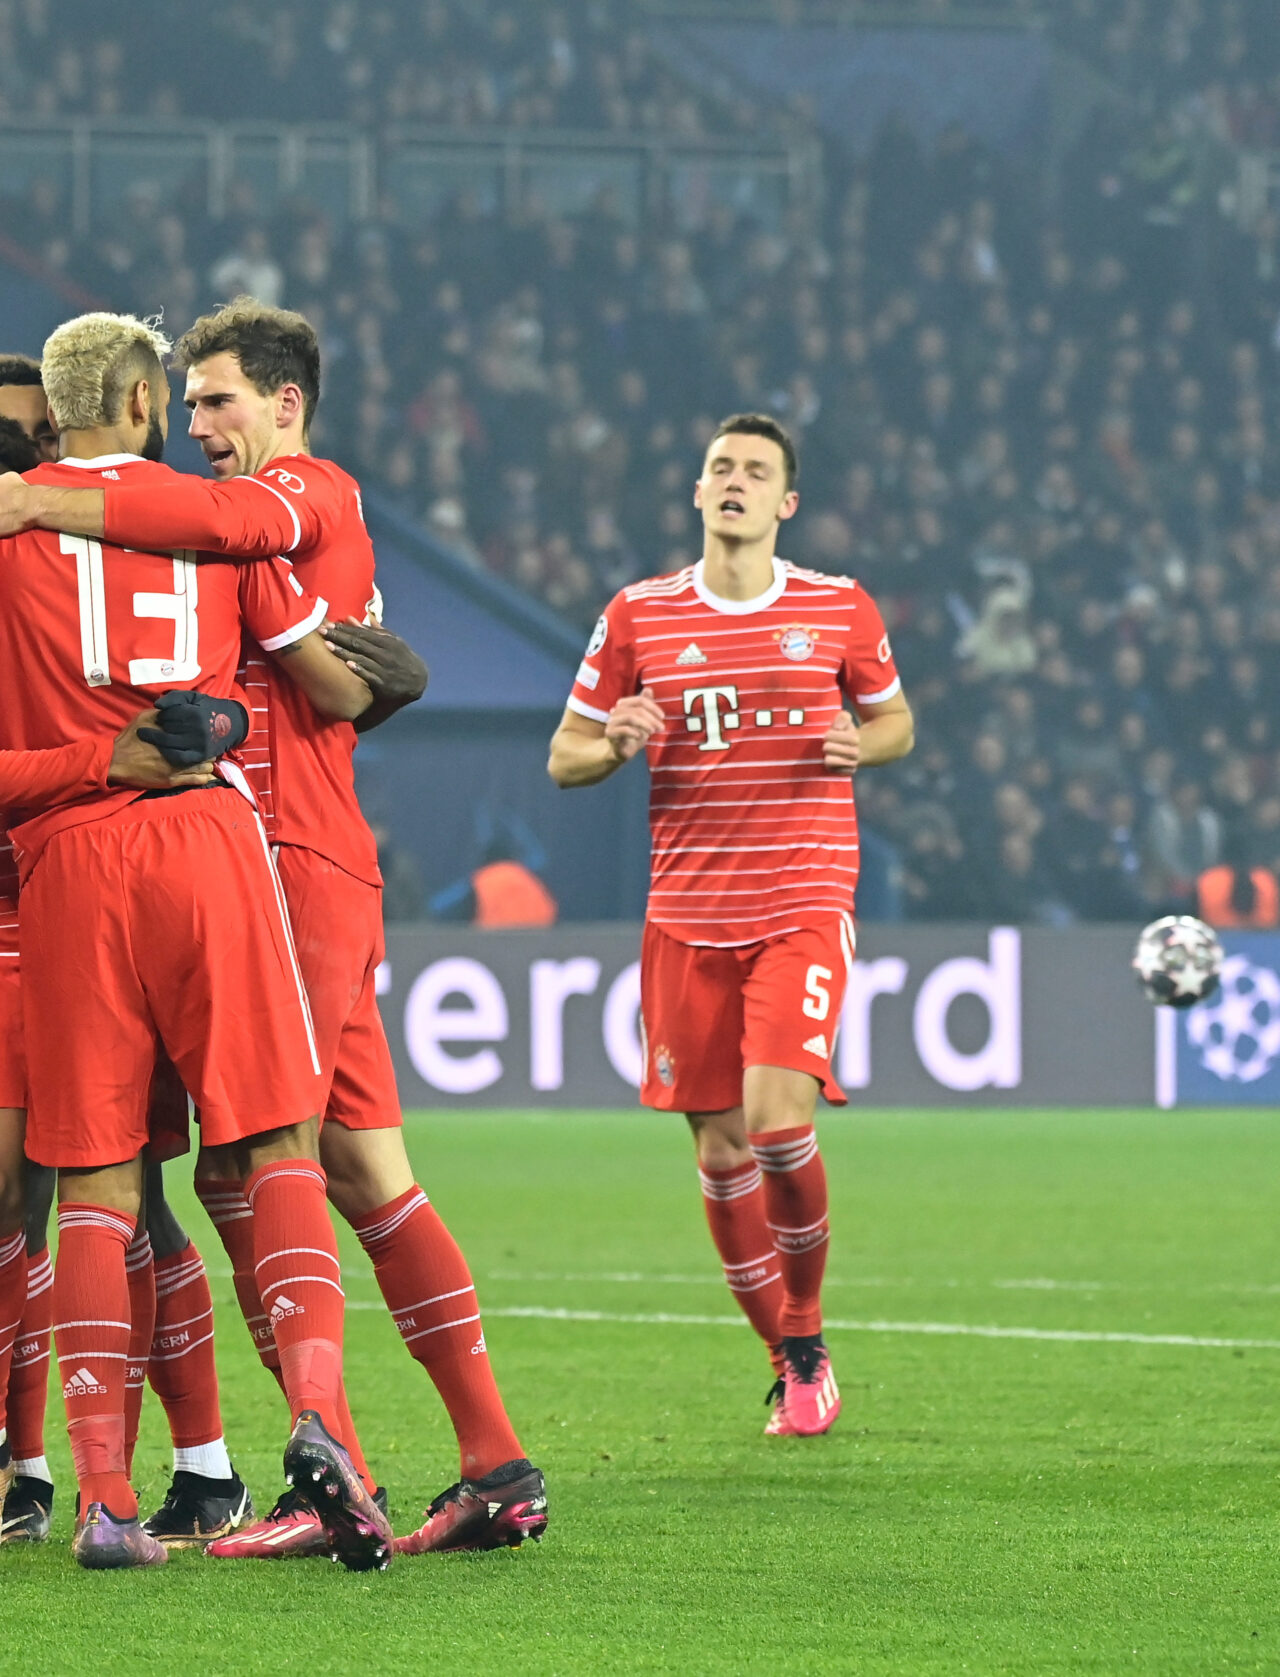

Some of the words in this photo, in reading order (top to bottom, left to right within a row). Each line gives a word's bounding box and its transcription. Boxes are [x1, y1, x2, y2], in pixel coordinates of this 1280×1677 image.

[59, 531, 201, 687] 13
[802, 964, 833, 1021] 5
[63, 1383, 108, 1399] adidas
